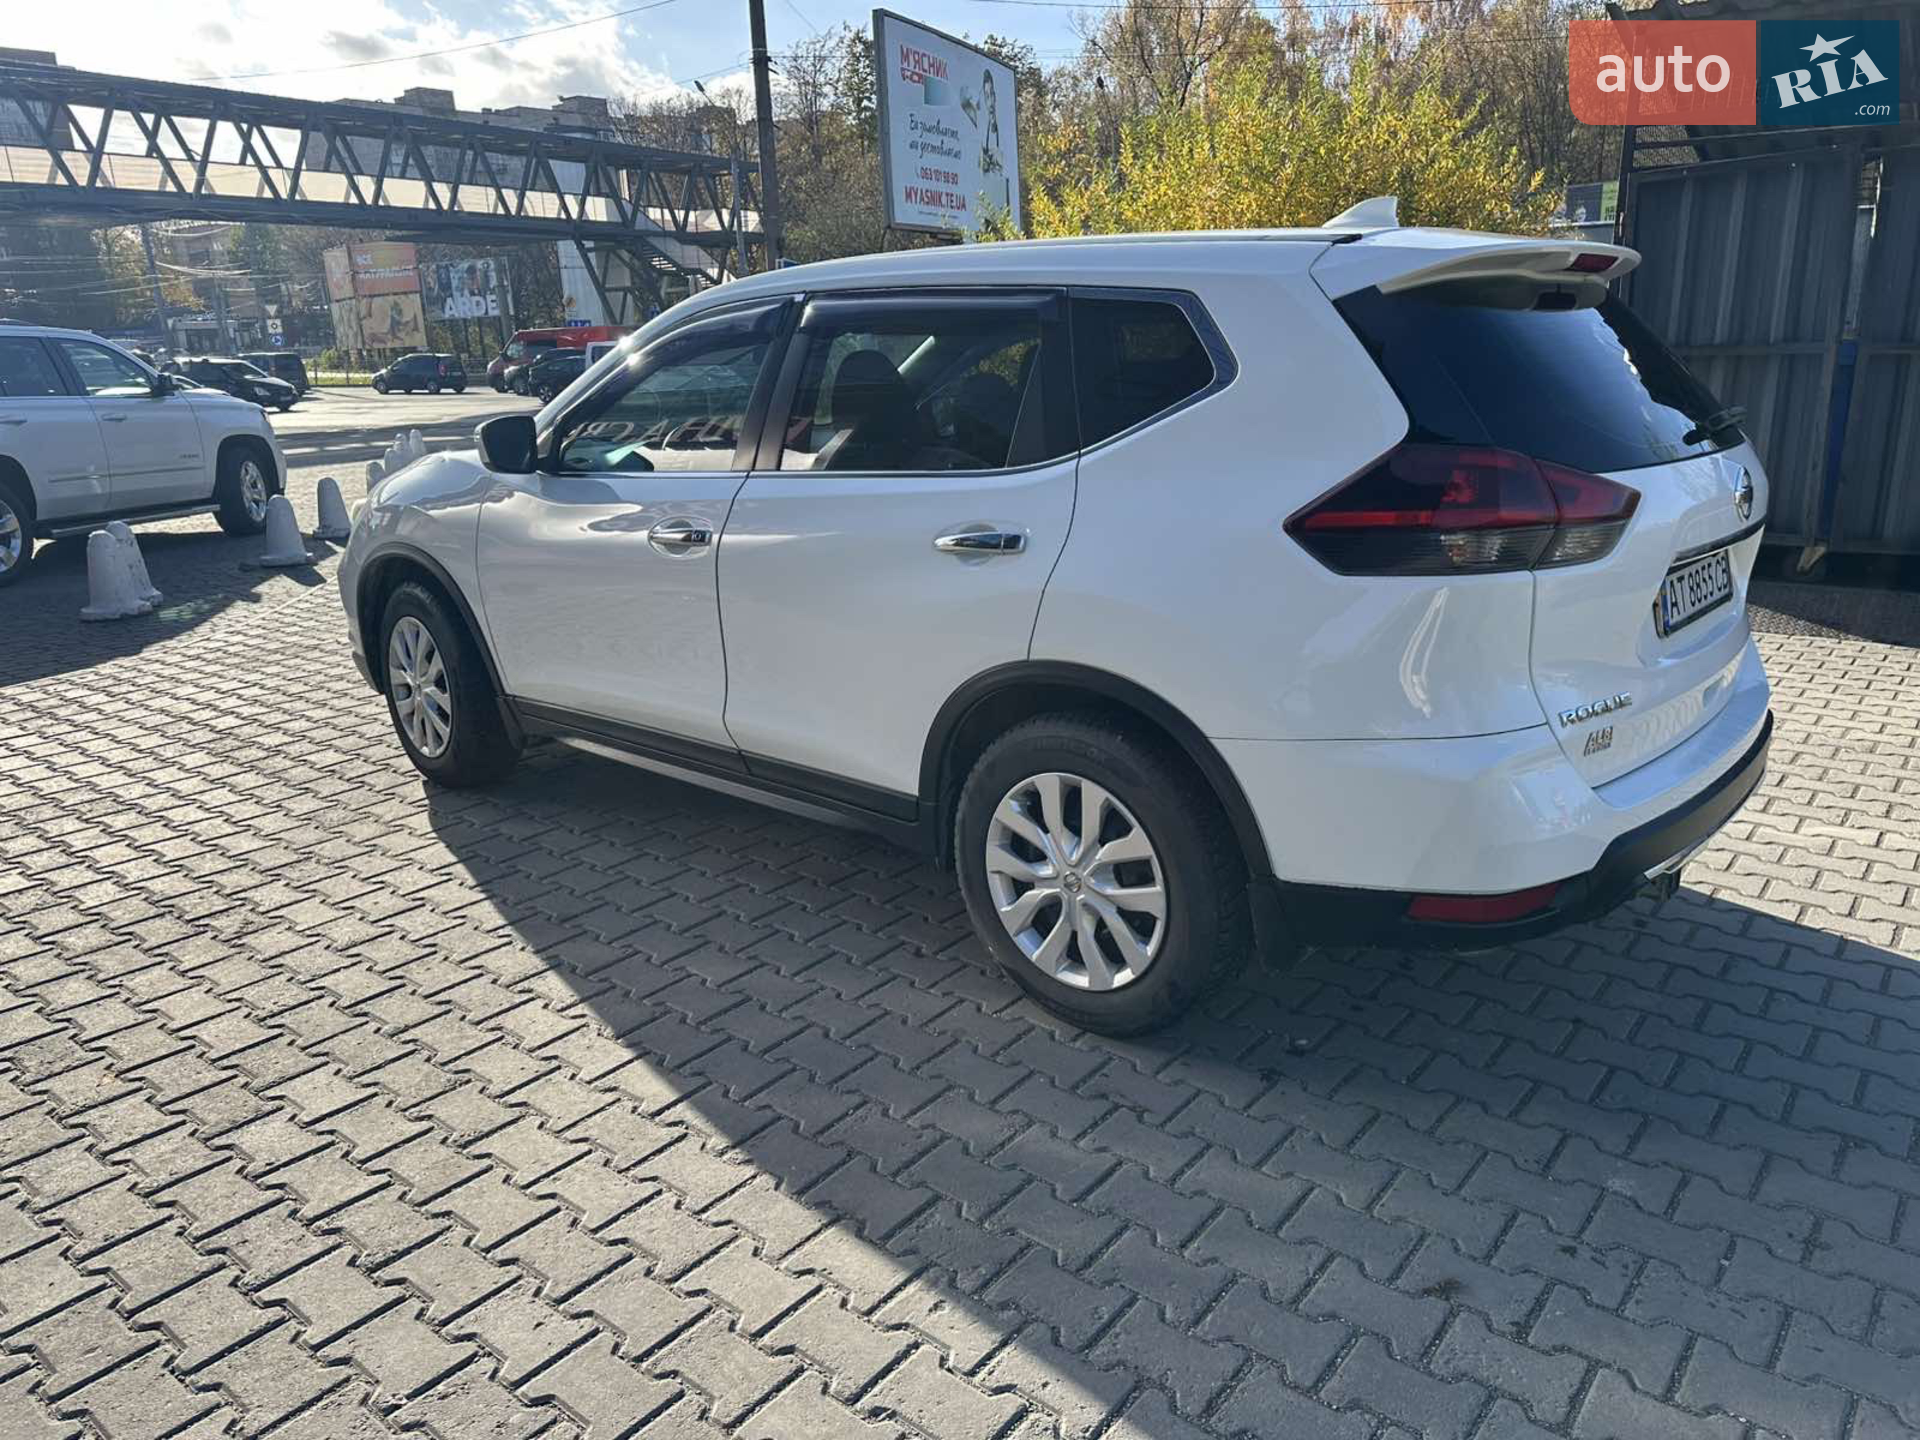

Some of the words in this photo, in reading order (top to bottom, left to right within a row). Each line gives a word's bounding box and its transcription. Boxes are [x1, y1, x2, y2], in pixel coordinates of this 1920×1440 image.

[1670, 575, 1686, 619] AT
[1688, 562, 1715, 608] 8855
[1558, 691, 1633, 728] ROGUE
